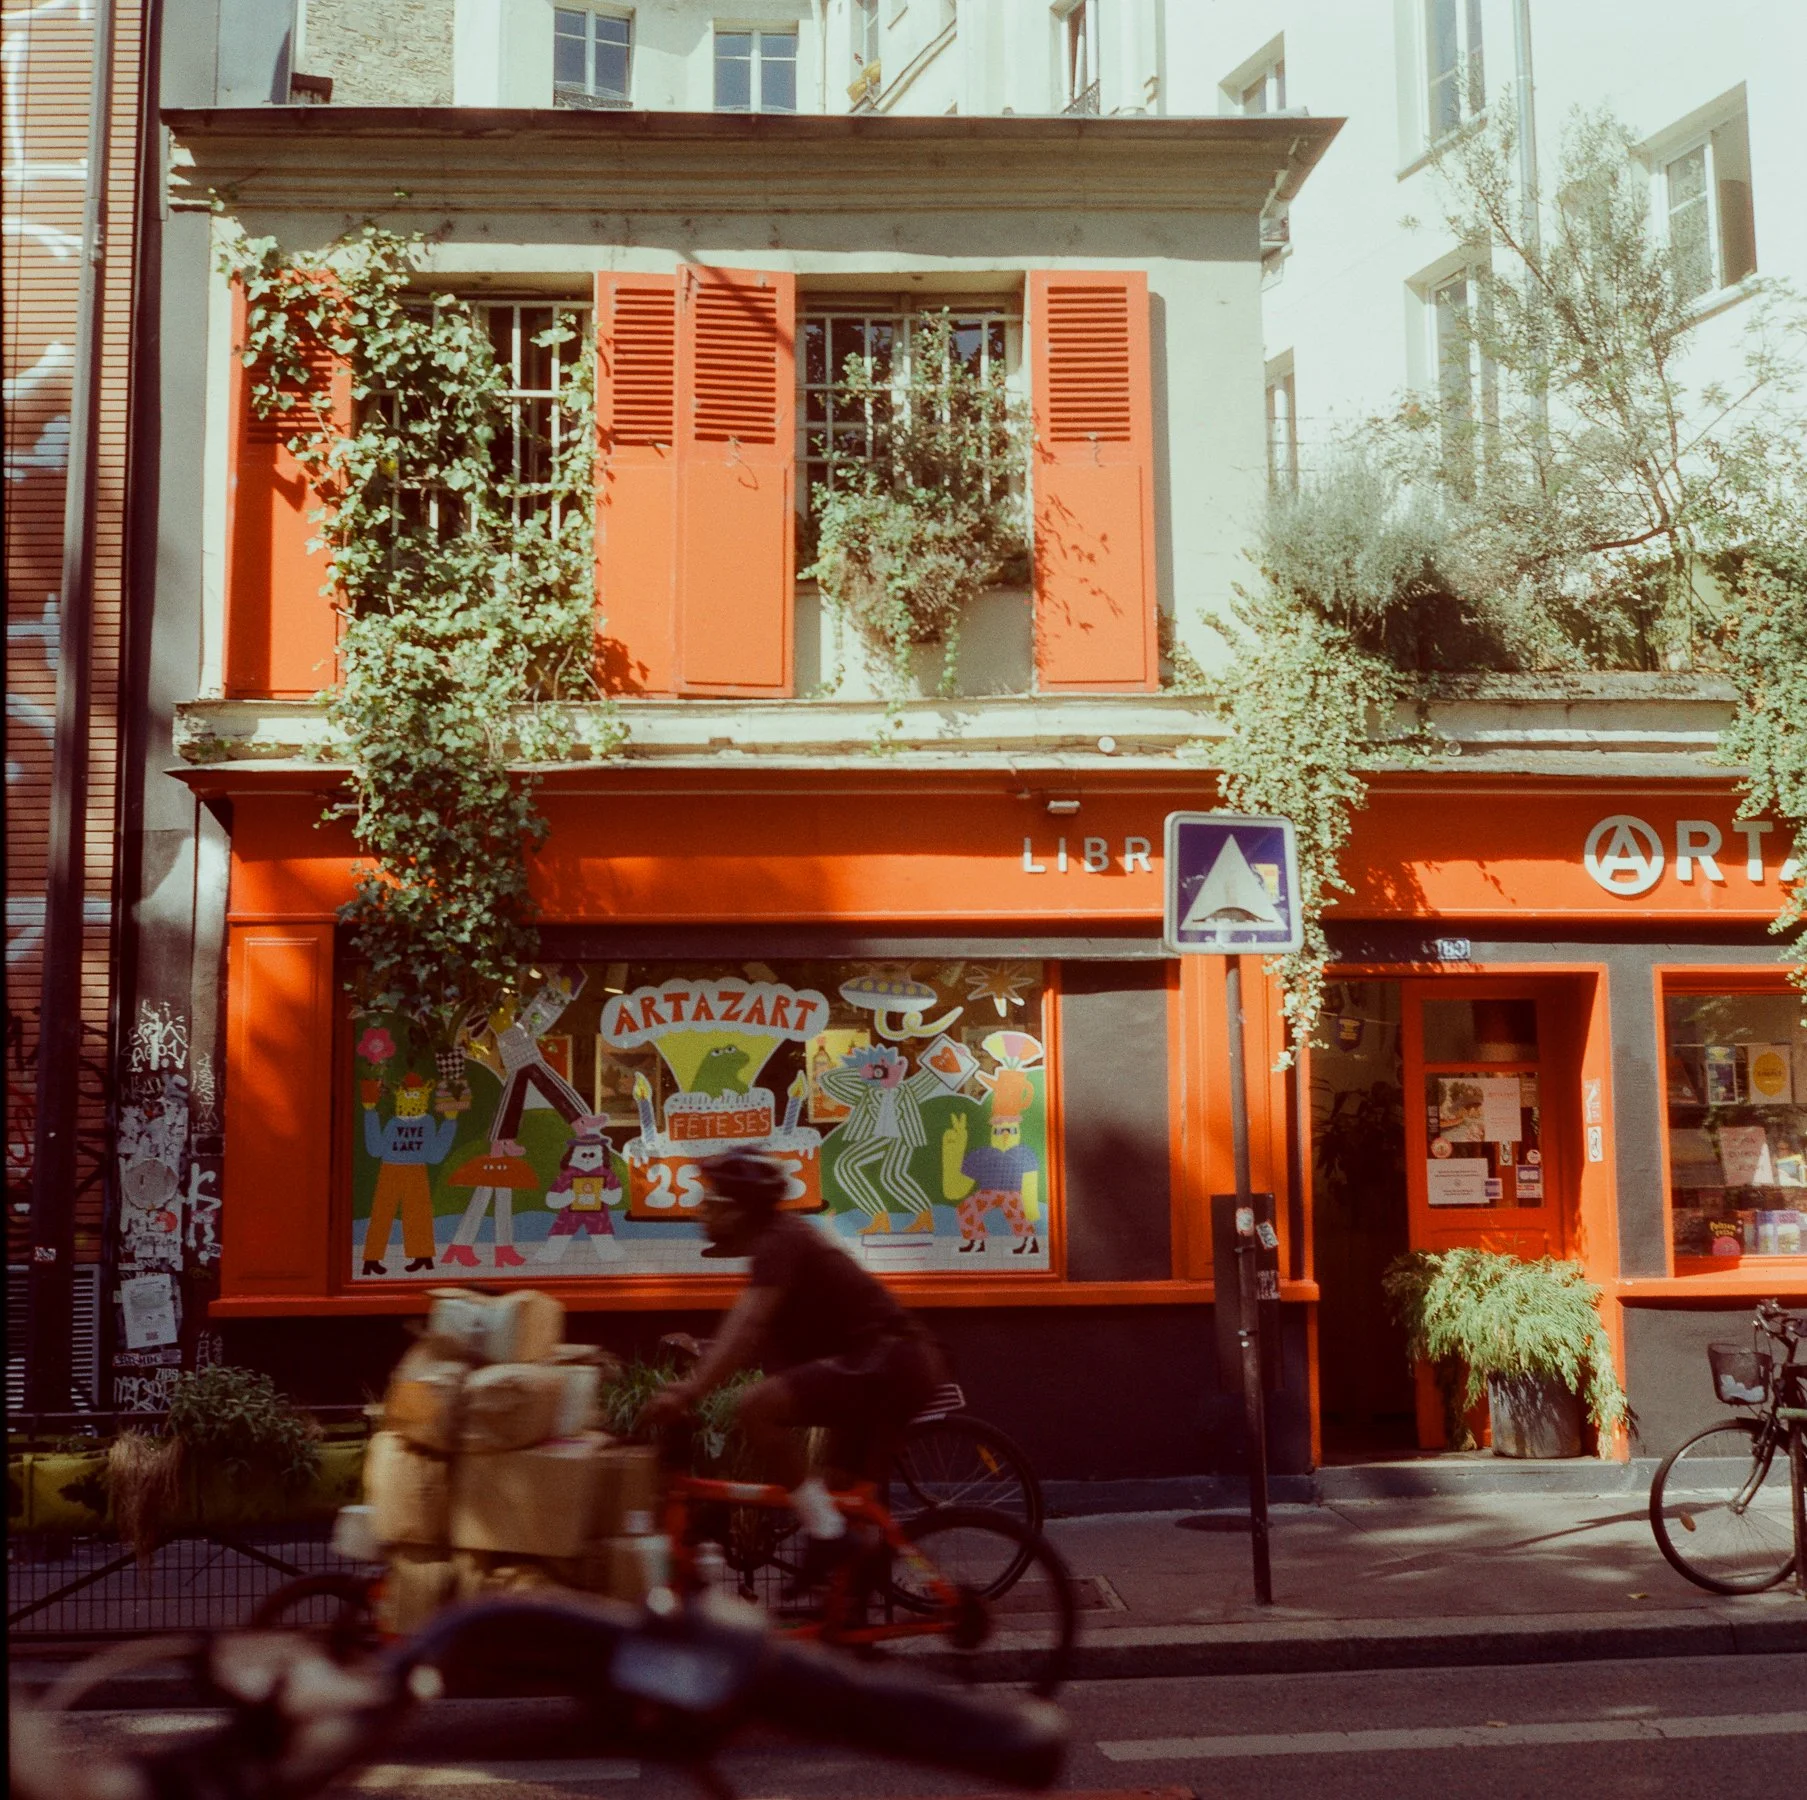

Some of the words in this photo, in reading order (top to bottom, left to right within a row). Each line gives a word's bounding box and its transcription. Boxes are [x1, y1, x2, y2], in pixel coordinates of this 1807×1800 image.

[613, 990, 819, 1036] ARTAZART
[395, 1126, 424, 1138] VIVE
[733, 1110, 772, 1135] SES
